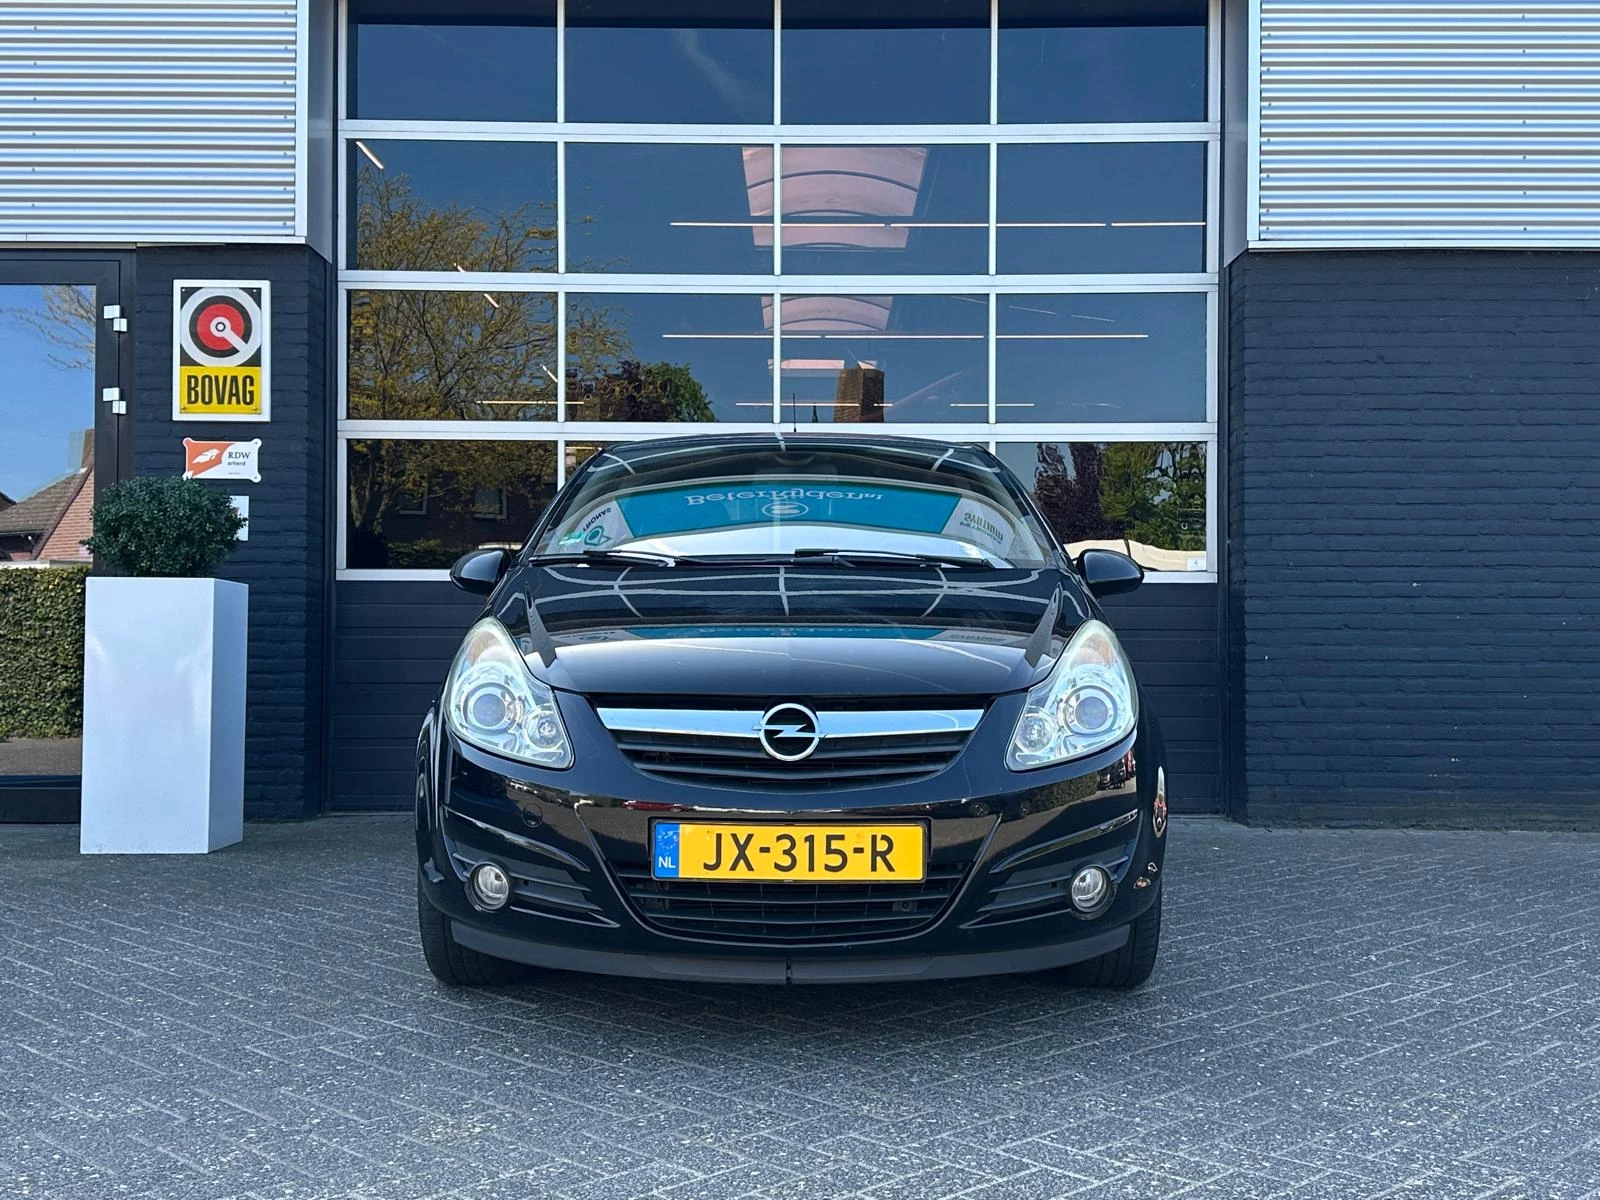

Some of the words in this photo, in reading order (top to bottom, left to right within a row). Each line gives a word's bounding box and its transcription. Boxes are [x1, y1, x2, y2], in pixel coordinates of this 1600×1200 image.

[187, 374, 254, 405] BOVAG
[228, 451, 251, 459] RDW
[658, 856, 676, 868] NL
[703, 833, 895, 872] JX-315-R
